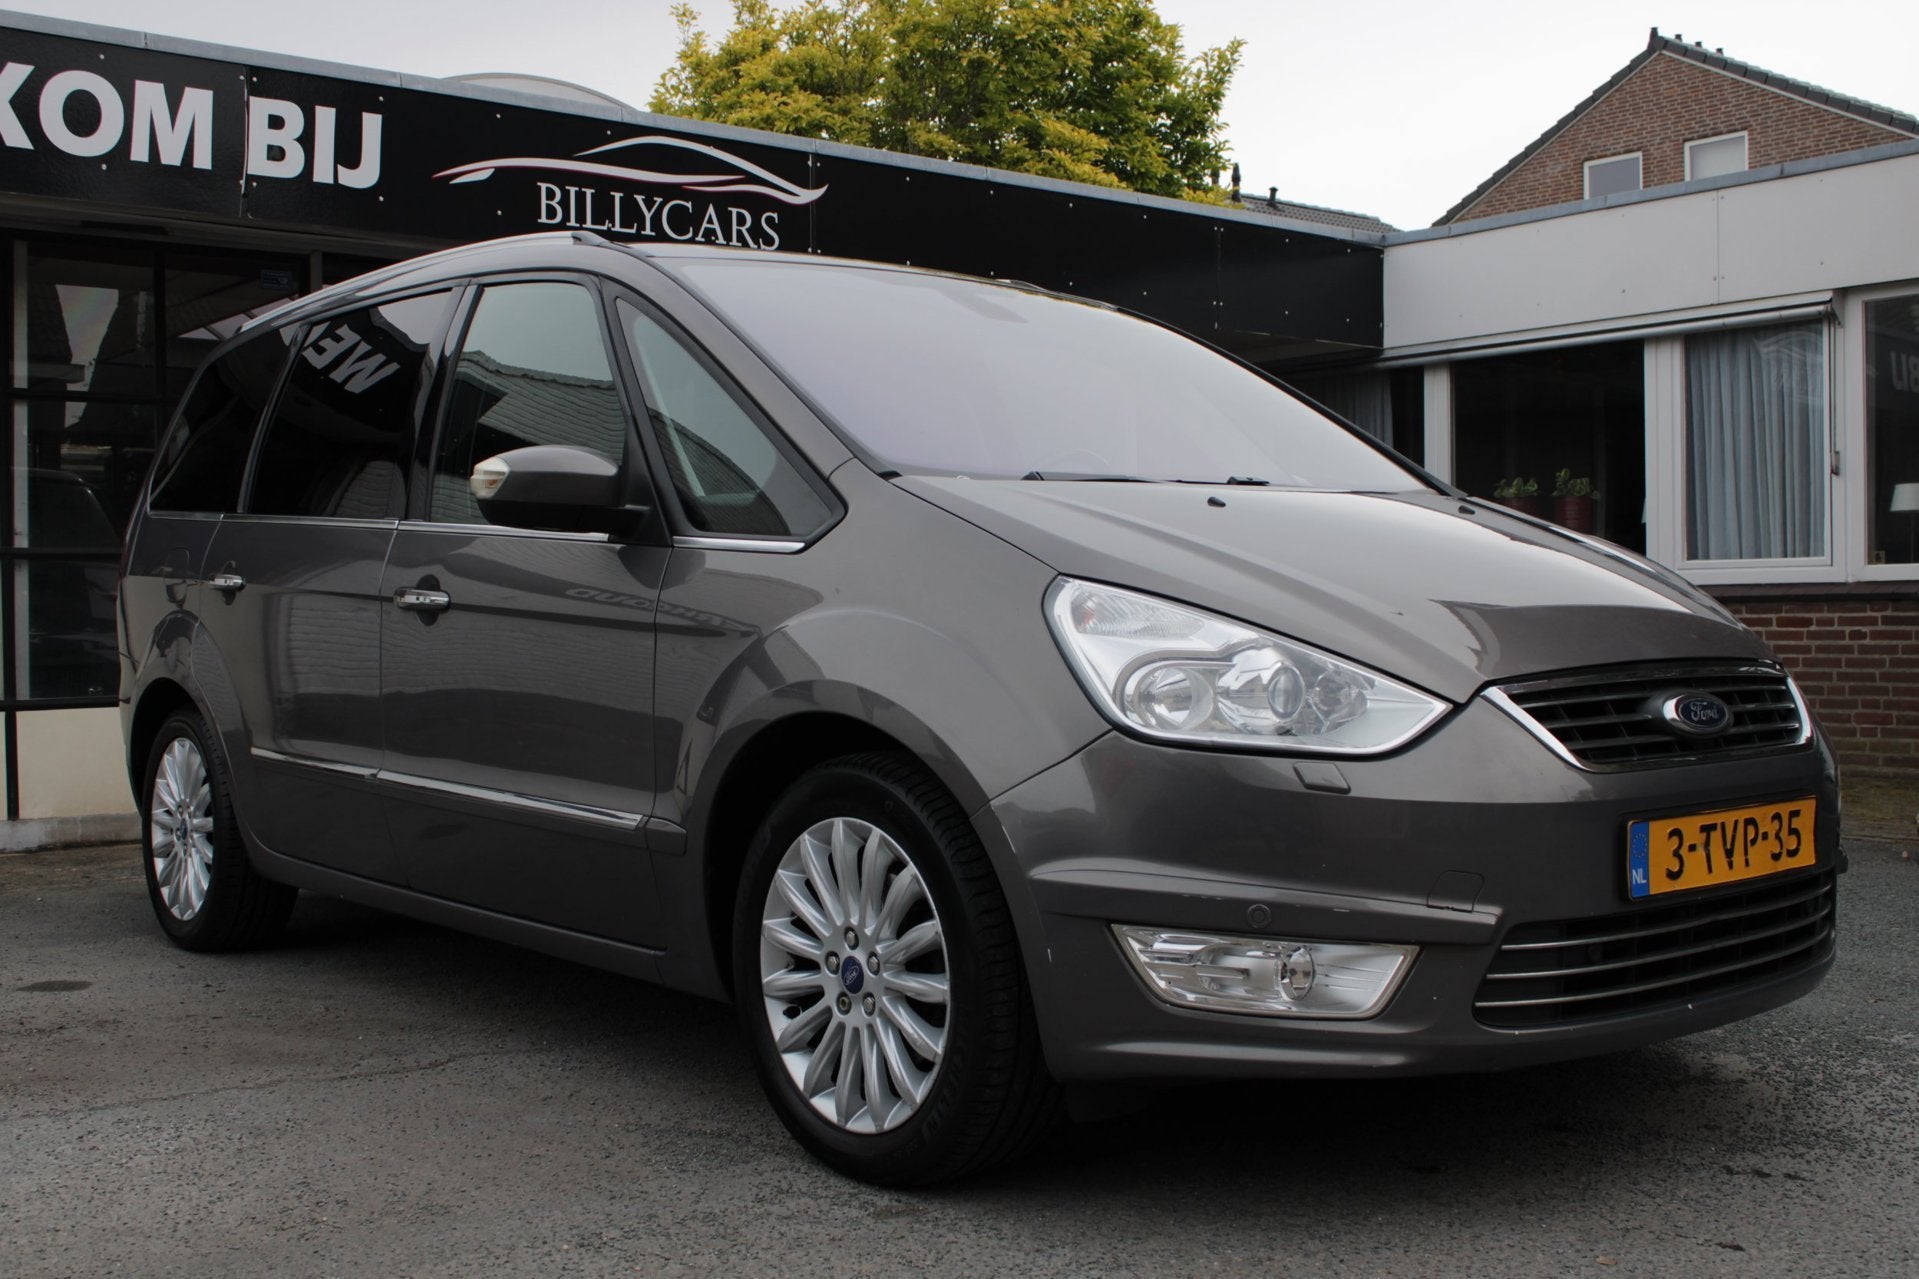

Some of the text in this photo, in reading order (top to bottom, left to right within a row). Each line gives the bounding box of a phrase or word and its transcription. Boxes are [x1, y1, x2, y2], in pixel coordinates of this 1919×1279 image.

[247, 95, 383, 189] BIJ
[536, 182, 780, 251] BILLYCARS
[1690, 701, 1719, 721] Ford
[1632, 867, 1647, 885] NL
[1665, 809, 1802, 881] 3-TVP-35
